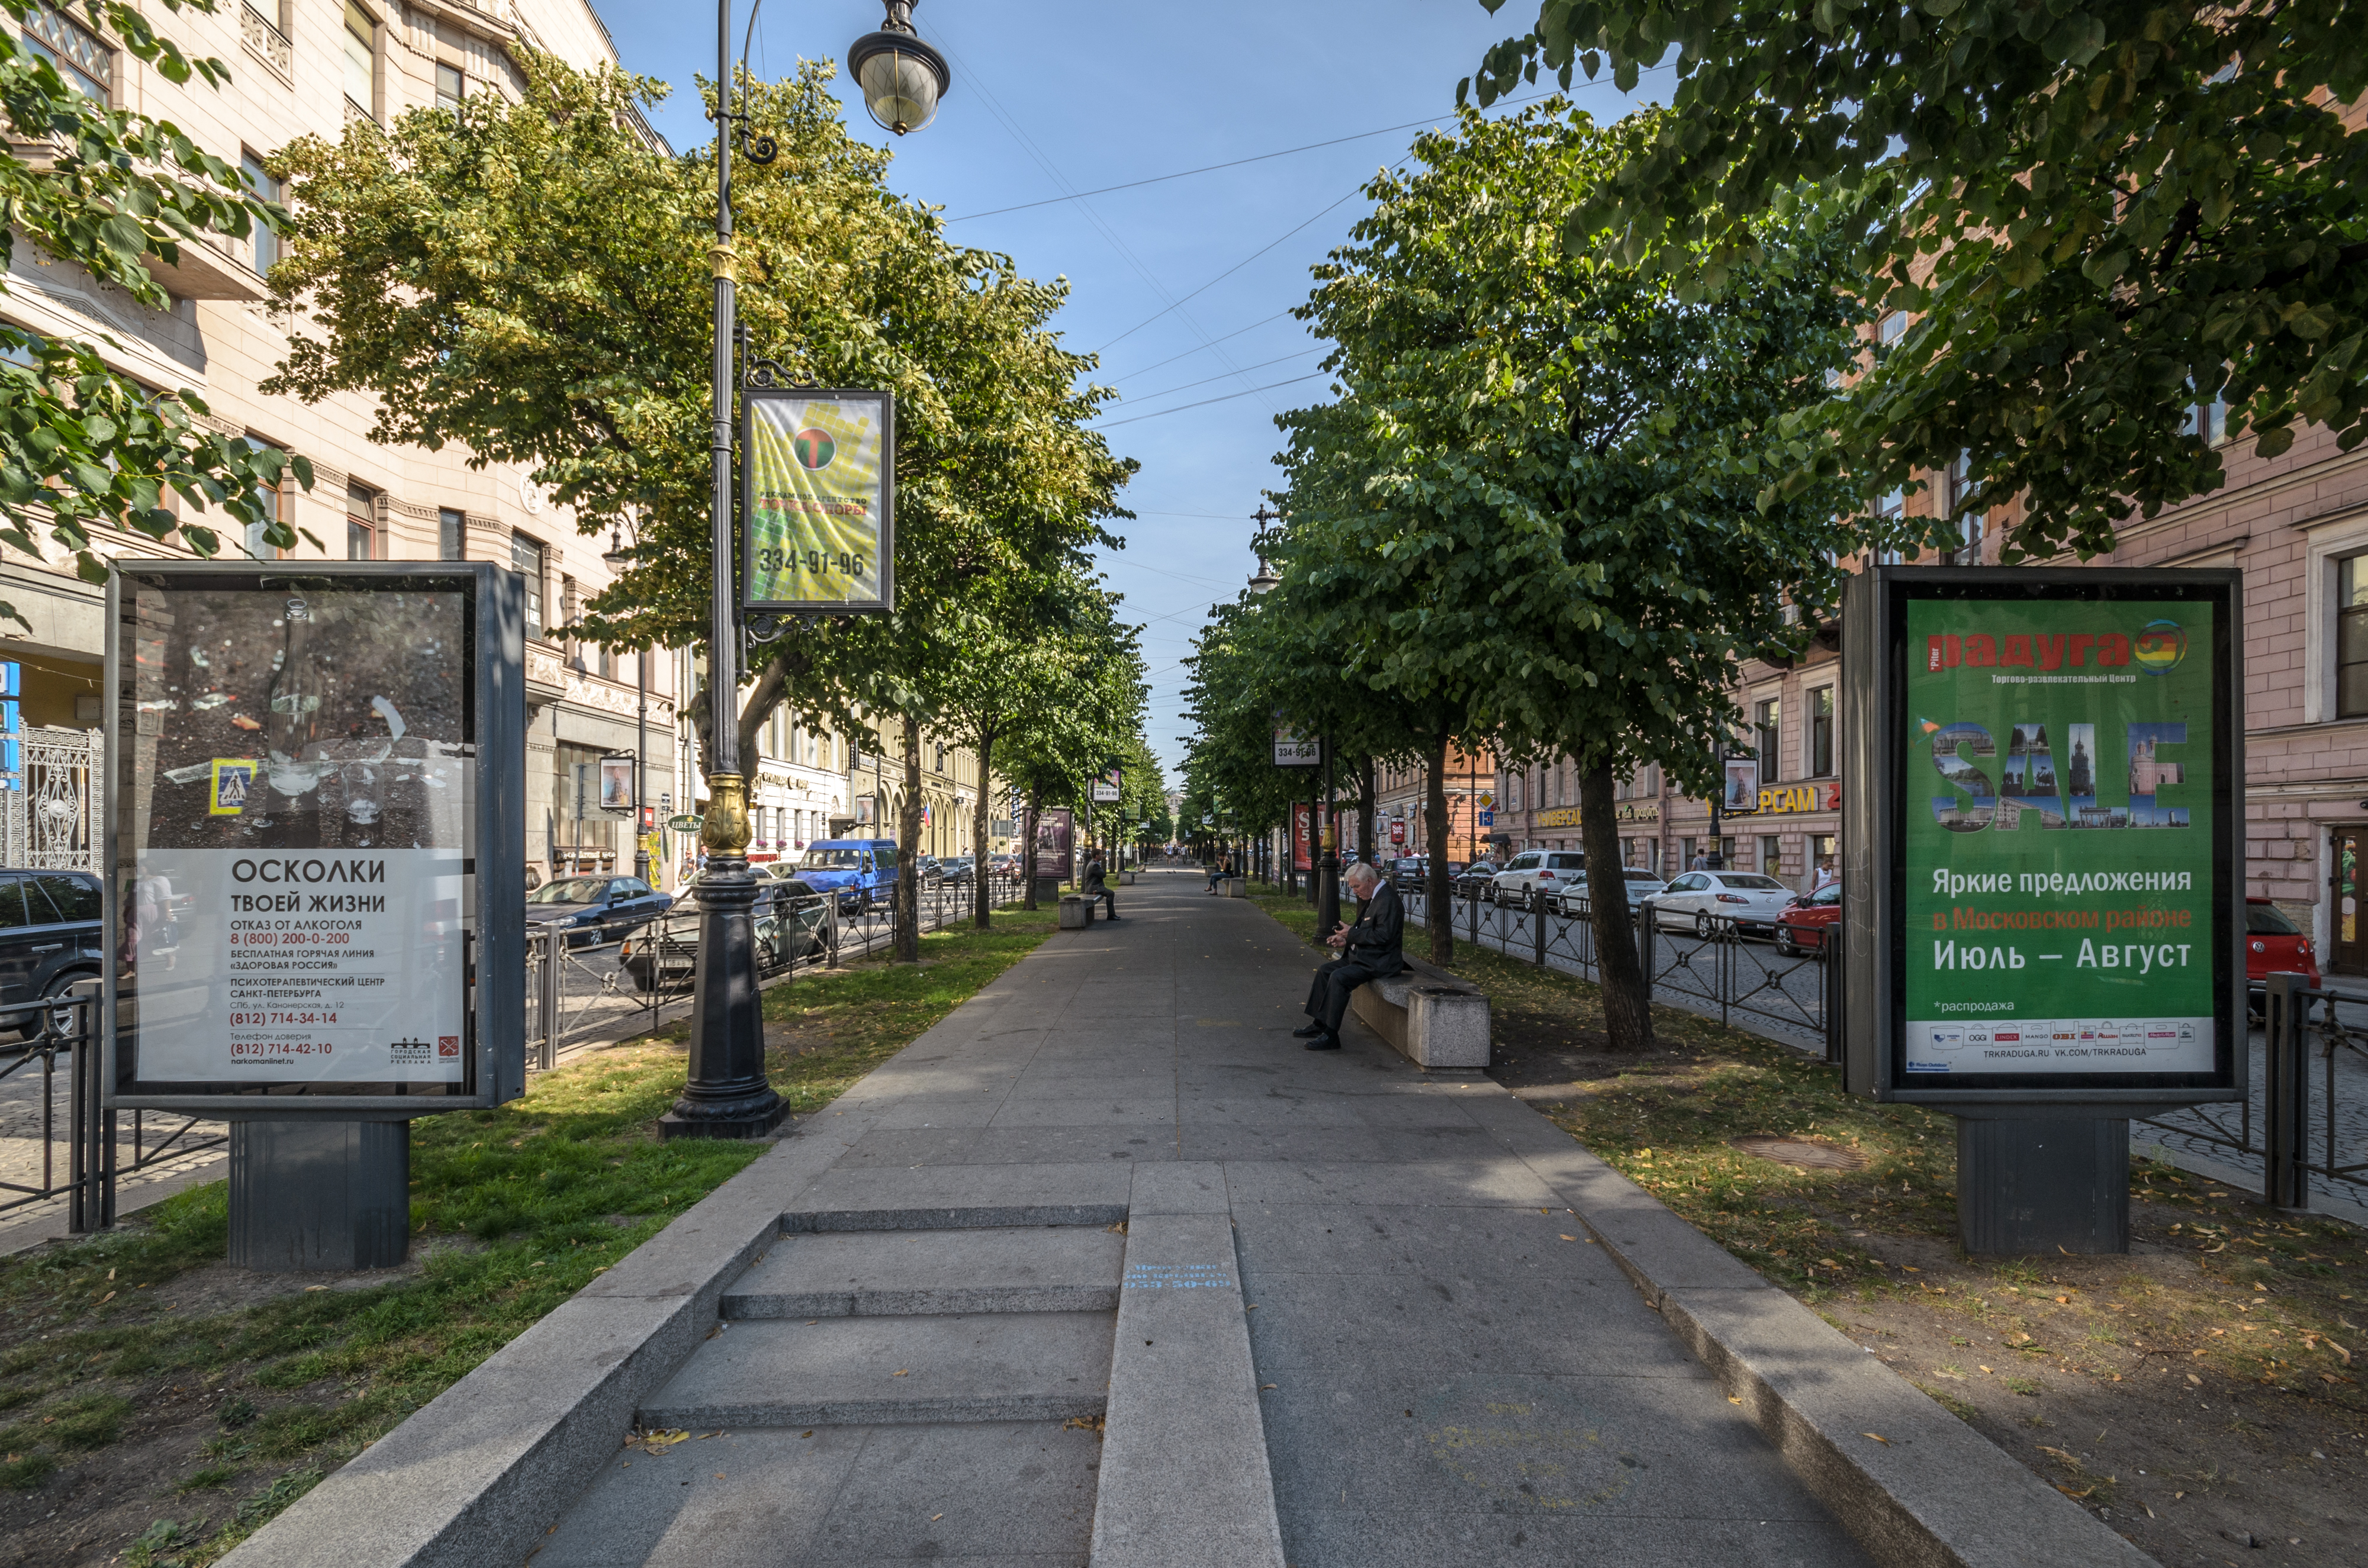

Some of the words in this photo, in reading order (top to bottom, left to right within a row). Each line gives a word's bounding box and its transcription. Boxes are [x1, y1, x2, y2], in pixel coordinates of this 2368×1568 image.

[760, 491, 813, 500] РЕКЛАМНОЕ
[816, 495, 867, 504] АГЕНТСТВО
[760, 499, 810, 513] ТОЧКА
[813, 503, 867, 516] ОПОРЫ
[759, 548, 864, 577] 334-91-96
[1928, 633, 2130, 672] радуга
[1991, 674, 2108, 684] Торгово-развлекательный
[2109, 674, 2136, 684] Центр
[1931, 722, 2190, 833] SALE
[671, 821, 702, 829] ЦВЕТЫ
[232, 859, 384, 883] ОСКОЛКИ
[1932, 868, 2012, 898] Яркие
[2020, 871, 2191, 897] предложения
[231, 891, 300, 912] ТВОЕЙ
[307, 894, 385, 913] ЖИЗНИ
[230, 920, 271, 930] ОТКАЗ
[275, 920, 290, 930] ОТ
[294, 920, 362, 930] АЛКОГОЛЯ
[1933, 912, 1947, 930] в
[1953, 907, 2099, 930] Московском
[2106, 905, 2191, 933] районе
[230, 933, 239, 945] 8
[243, 932, 278, 947] (800)
[282, 932, 350, 944] 200-0-200
[297, 949, 339, 958] ГОРЯЧАЯ
[342, 949, 374, 958] ЛИНИЯ
[1933, 939, 2025, 970] Июль
[2076, 938, 2191, 974] Август
[230, 961, 289, 971] «ЗДОРОВАЯ
[292, 961, 338, 970] РОССИЯ»
[230, 976, 355, 986] ПСИХОТЕРАПЕВТИЧЕСКИЙ
[358, 978, 385, 987] ЦЕНТР
[230, 990, 321, 998] САНКТ-ПЕТЕРБУРГА
[230, 1002, 250, 1010] СПб,
[267, 1002, 323, 1010] Канонерская,
[230, 1012, 266, 1027] (812)
[271, 1012, 337, 1024] 714-34-14
[230, 1033, 272, 1042] Телефон
[230, 1043, 264, 1057] (812)
[268, 1043, 332, 1054] 714-42-10
[1984, 1049, 2050, 1058] TRKRADUGA.RU
[2055, 1048, 2147, 1058] VK.COM/TRKRADUGA
